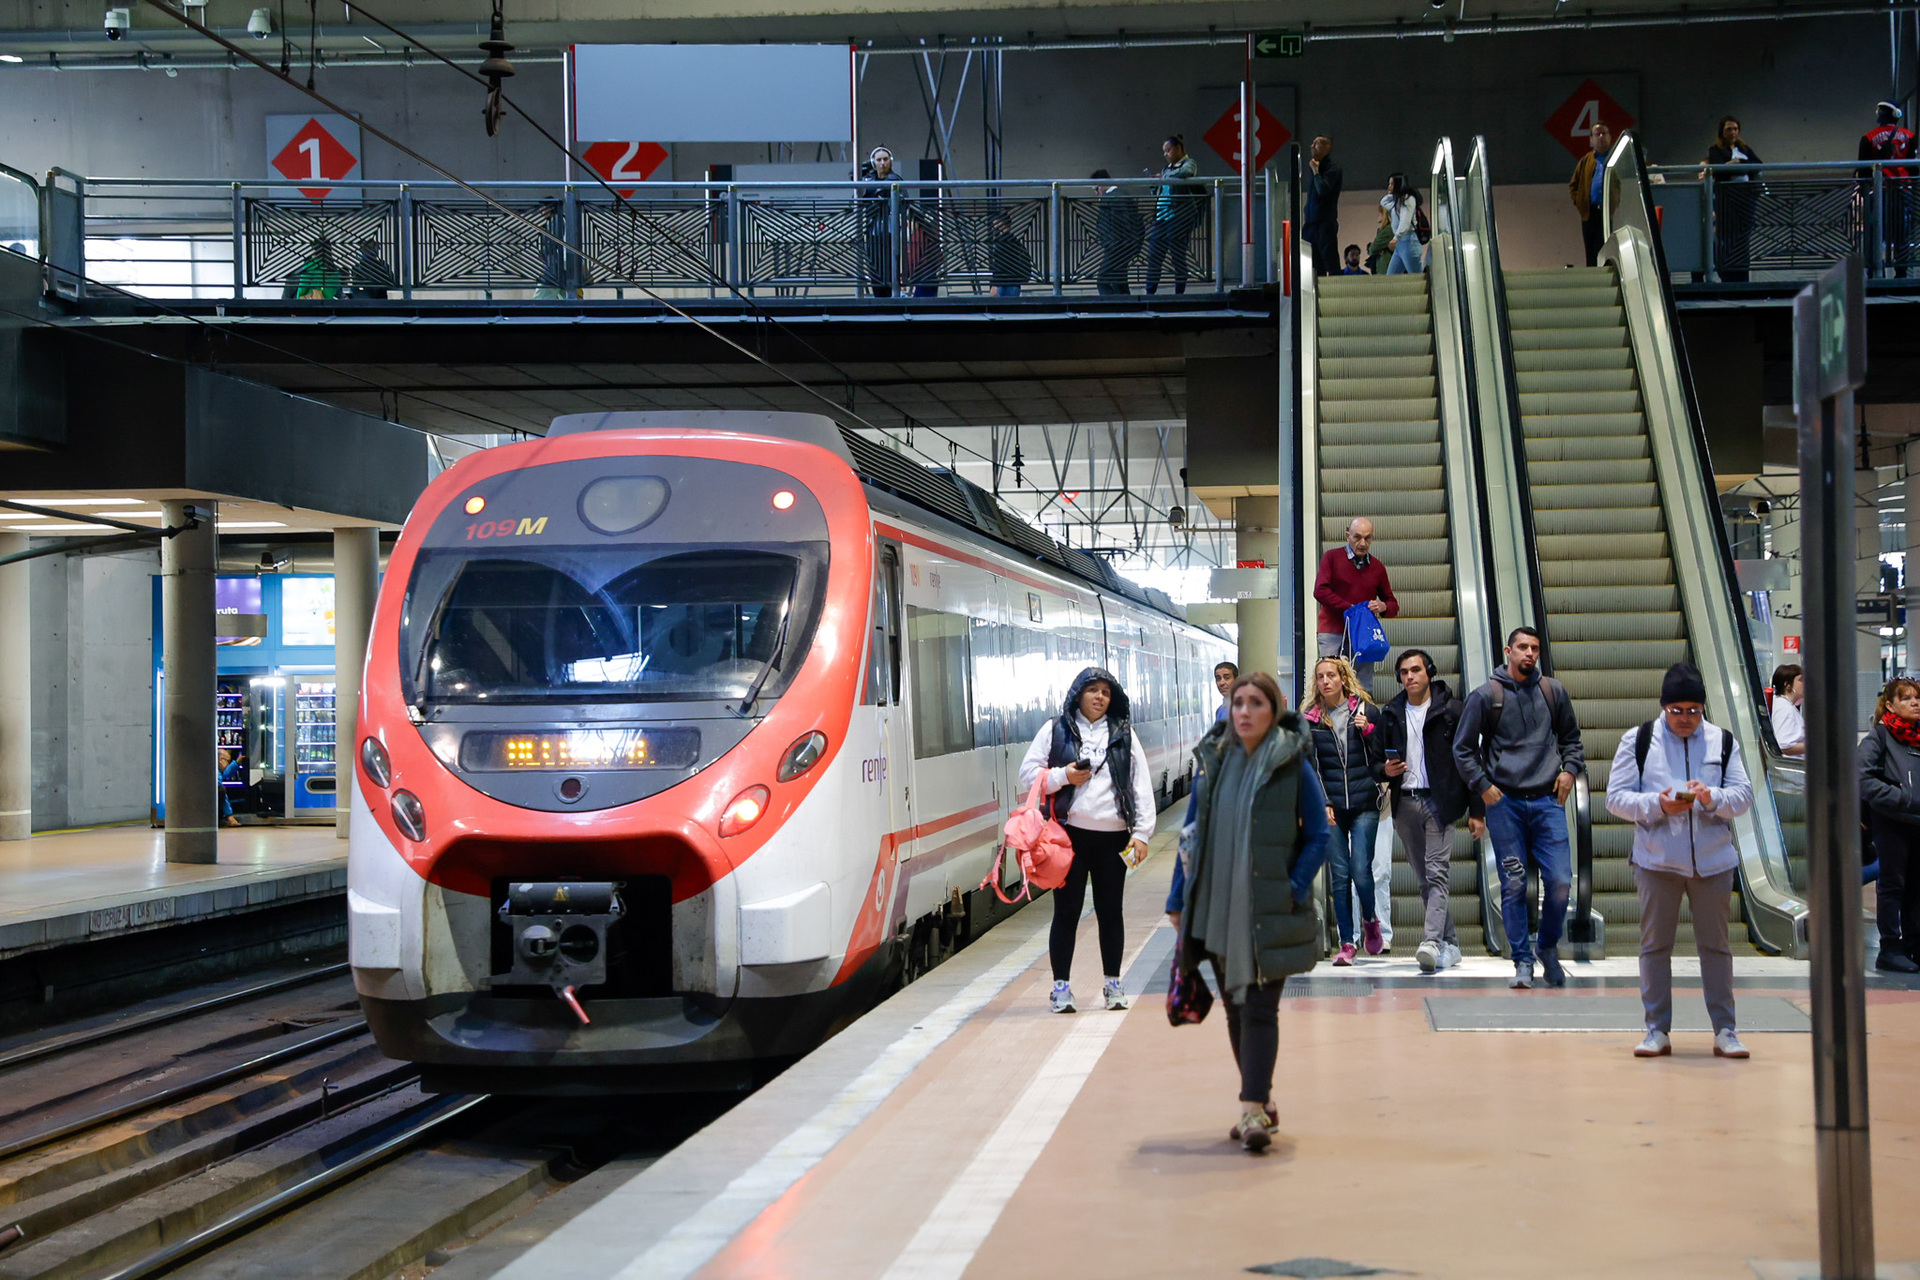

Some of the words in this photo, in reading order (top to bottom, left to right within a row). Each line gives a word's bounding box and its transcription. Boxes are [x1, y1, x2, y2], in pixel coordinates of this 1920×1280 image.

[1233, 113, 1262, 161] 3
[1571, 100, 1600, 147] 4
[299, 138, 330, 180] 1
[611, 141, 642, 180] 2
[465, 517, 549, 540] 109M
[861, 742, 887, 797] renfe
